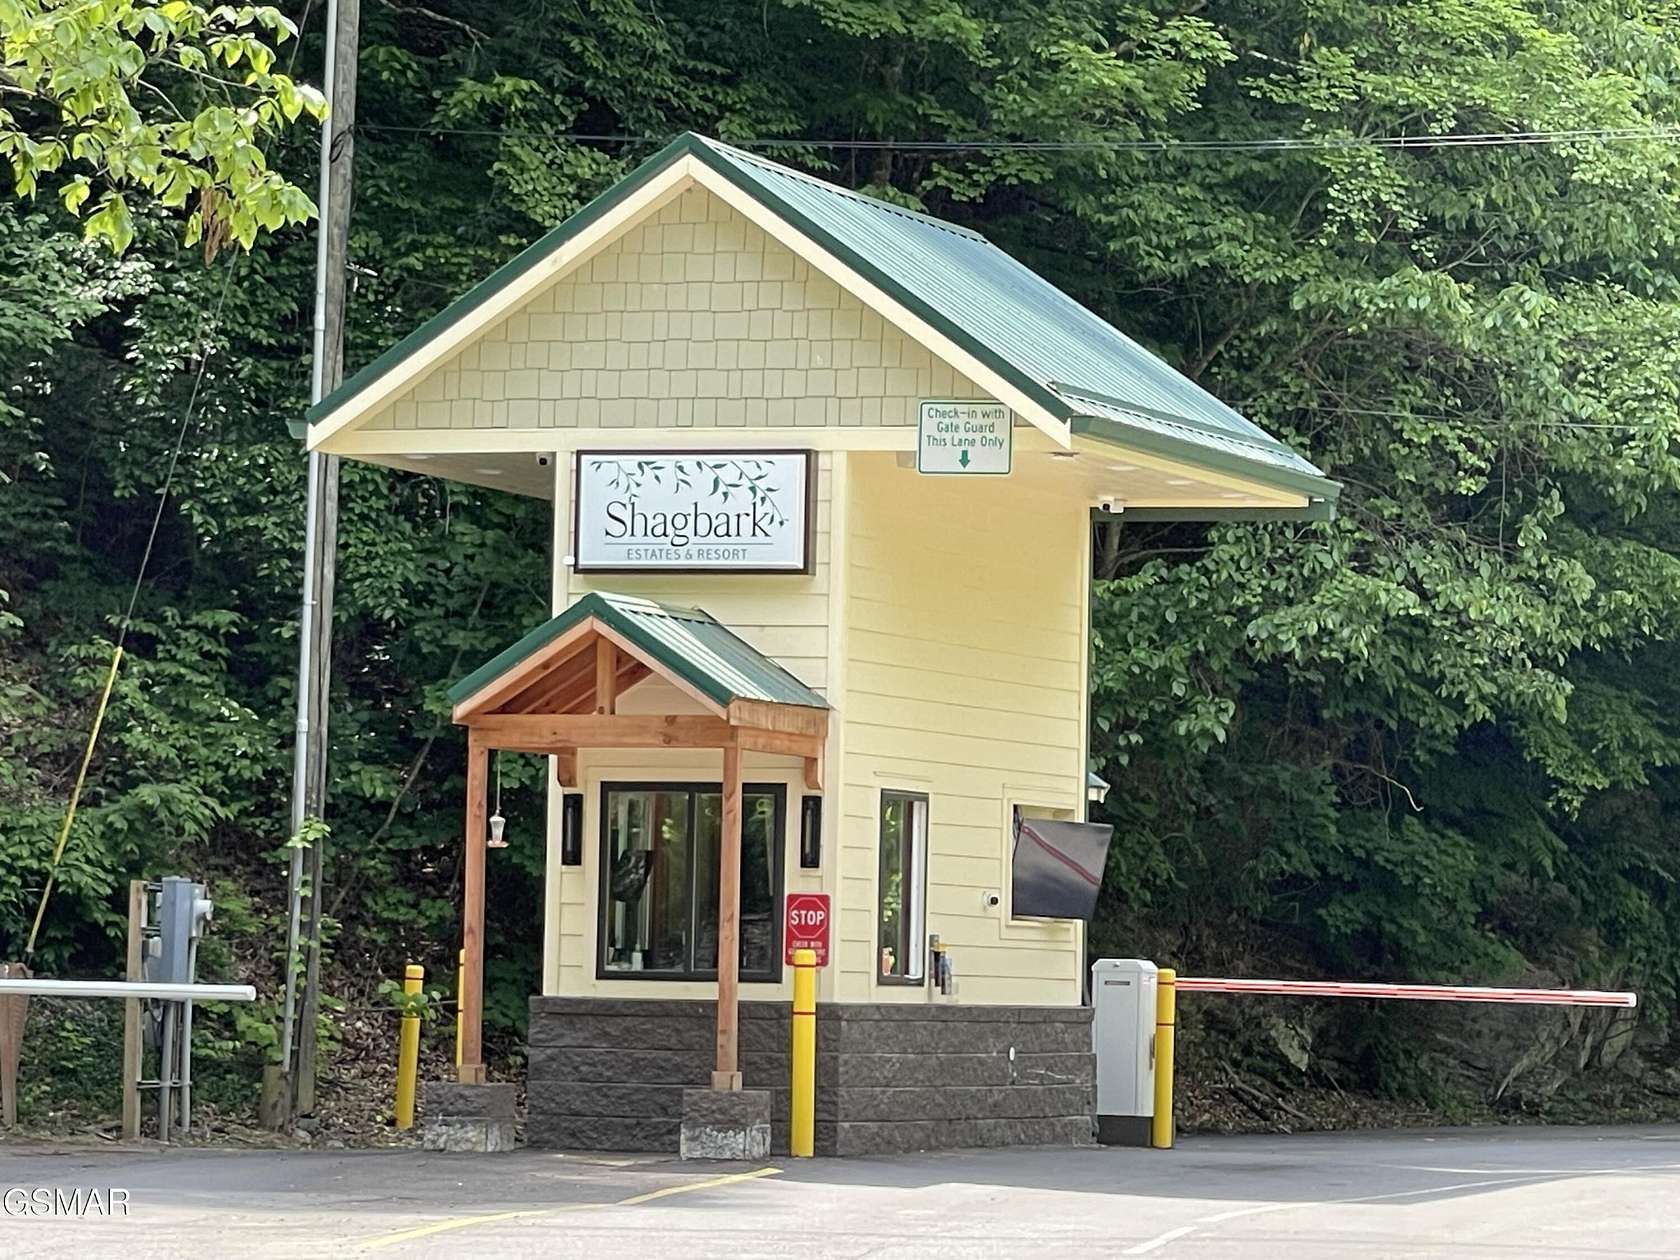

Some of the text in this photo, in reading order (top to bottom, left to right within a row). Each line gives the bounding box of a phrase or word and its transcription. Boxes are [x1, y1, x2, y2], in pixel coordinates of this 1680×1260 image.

[927, 407, 1005, 419] Check-in with
[937, 421, 995, 433] Gate Guard
[926, 435, 1004, 450] This Lane Only
[604, 500, 772, 547] Shagbark
[627, 548, 748, 560] ESTATES & RESORT
[791, 909, 825, 926] STOP
